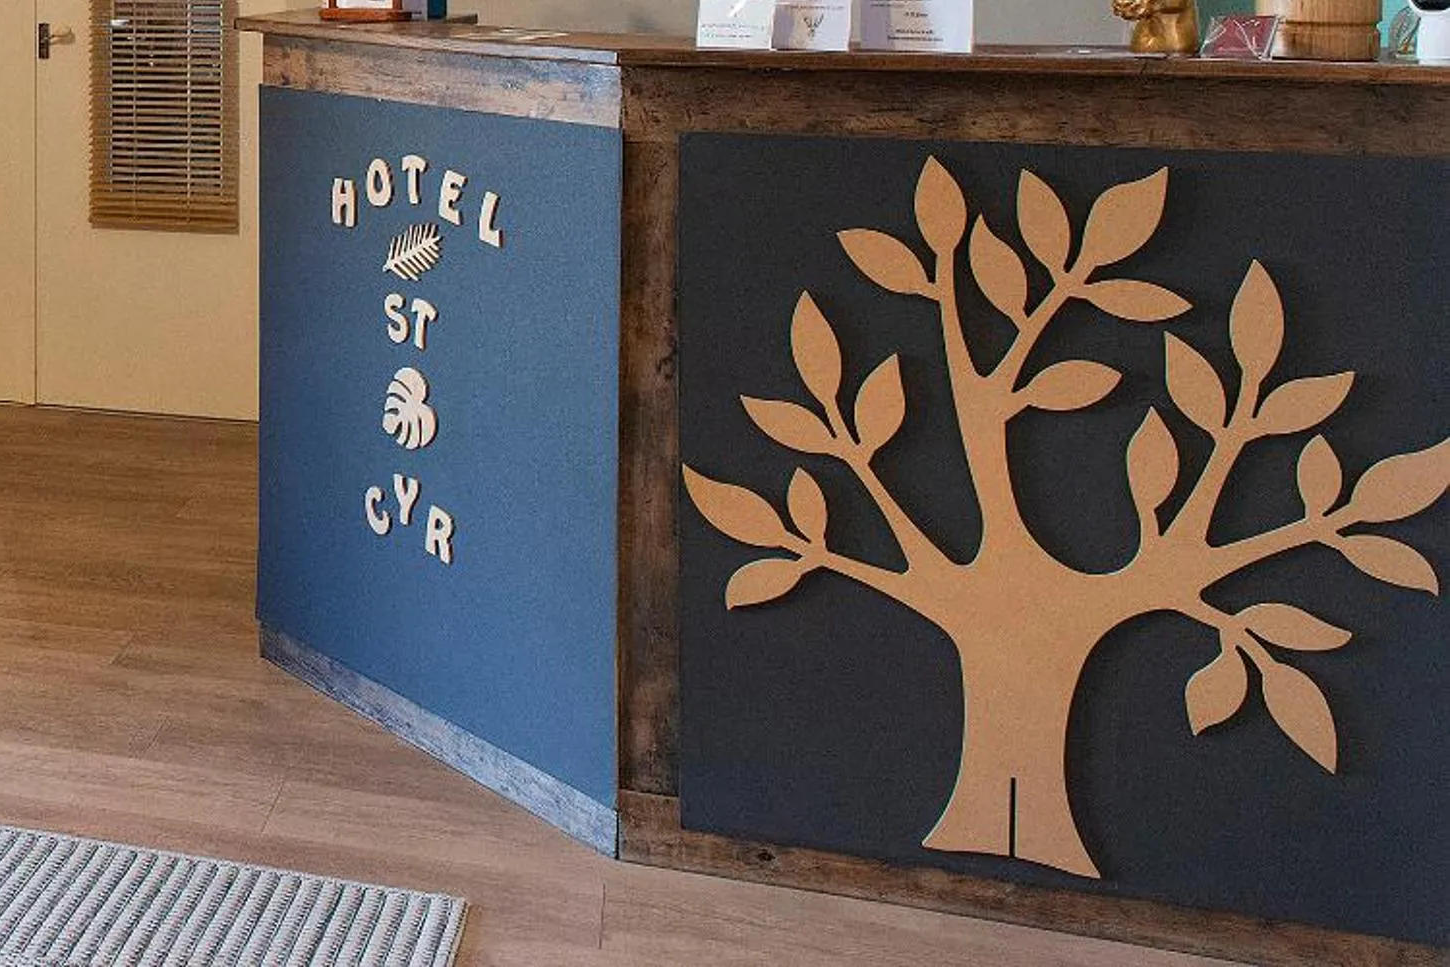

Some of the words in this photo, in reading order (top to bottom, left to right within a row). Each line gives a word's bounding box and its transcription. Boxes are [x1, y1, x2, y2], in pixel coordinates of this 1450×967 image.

[332, 154, 505, 248] HOTEL
[384, 293, 437, 350] ST
[364, 473, 453, 565] CYR
